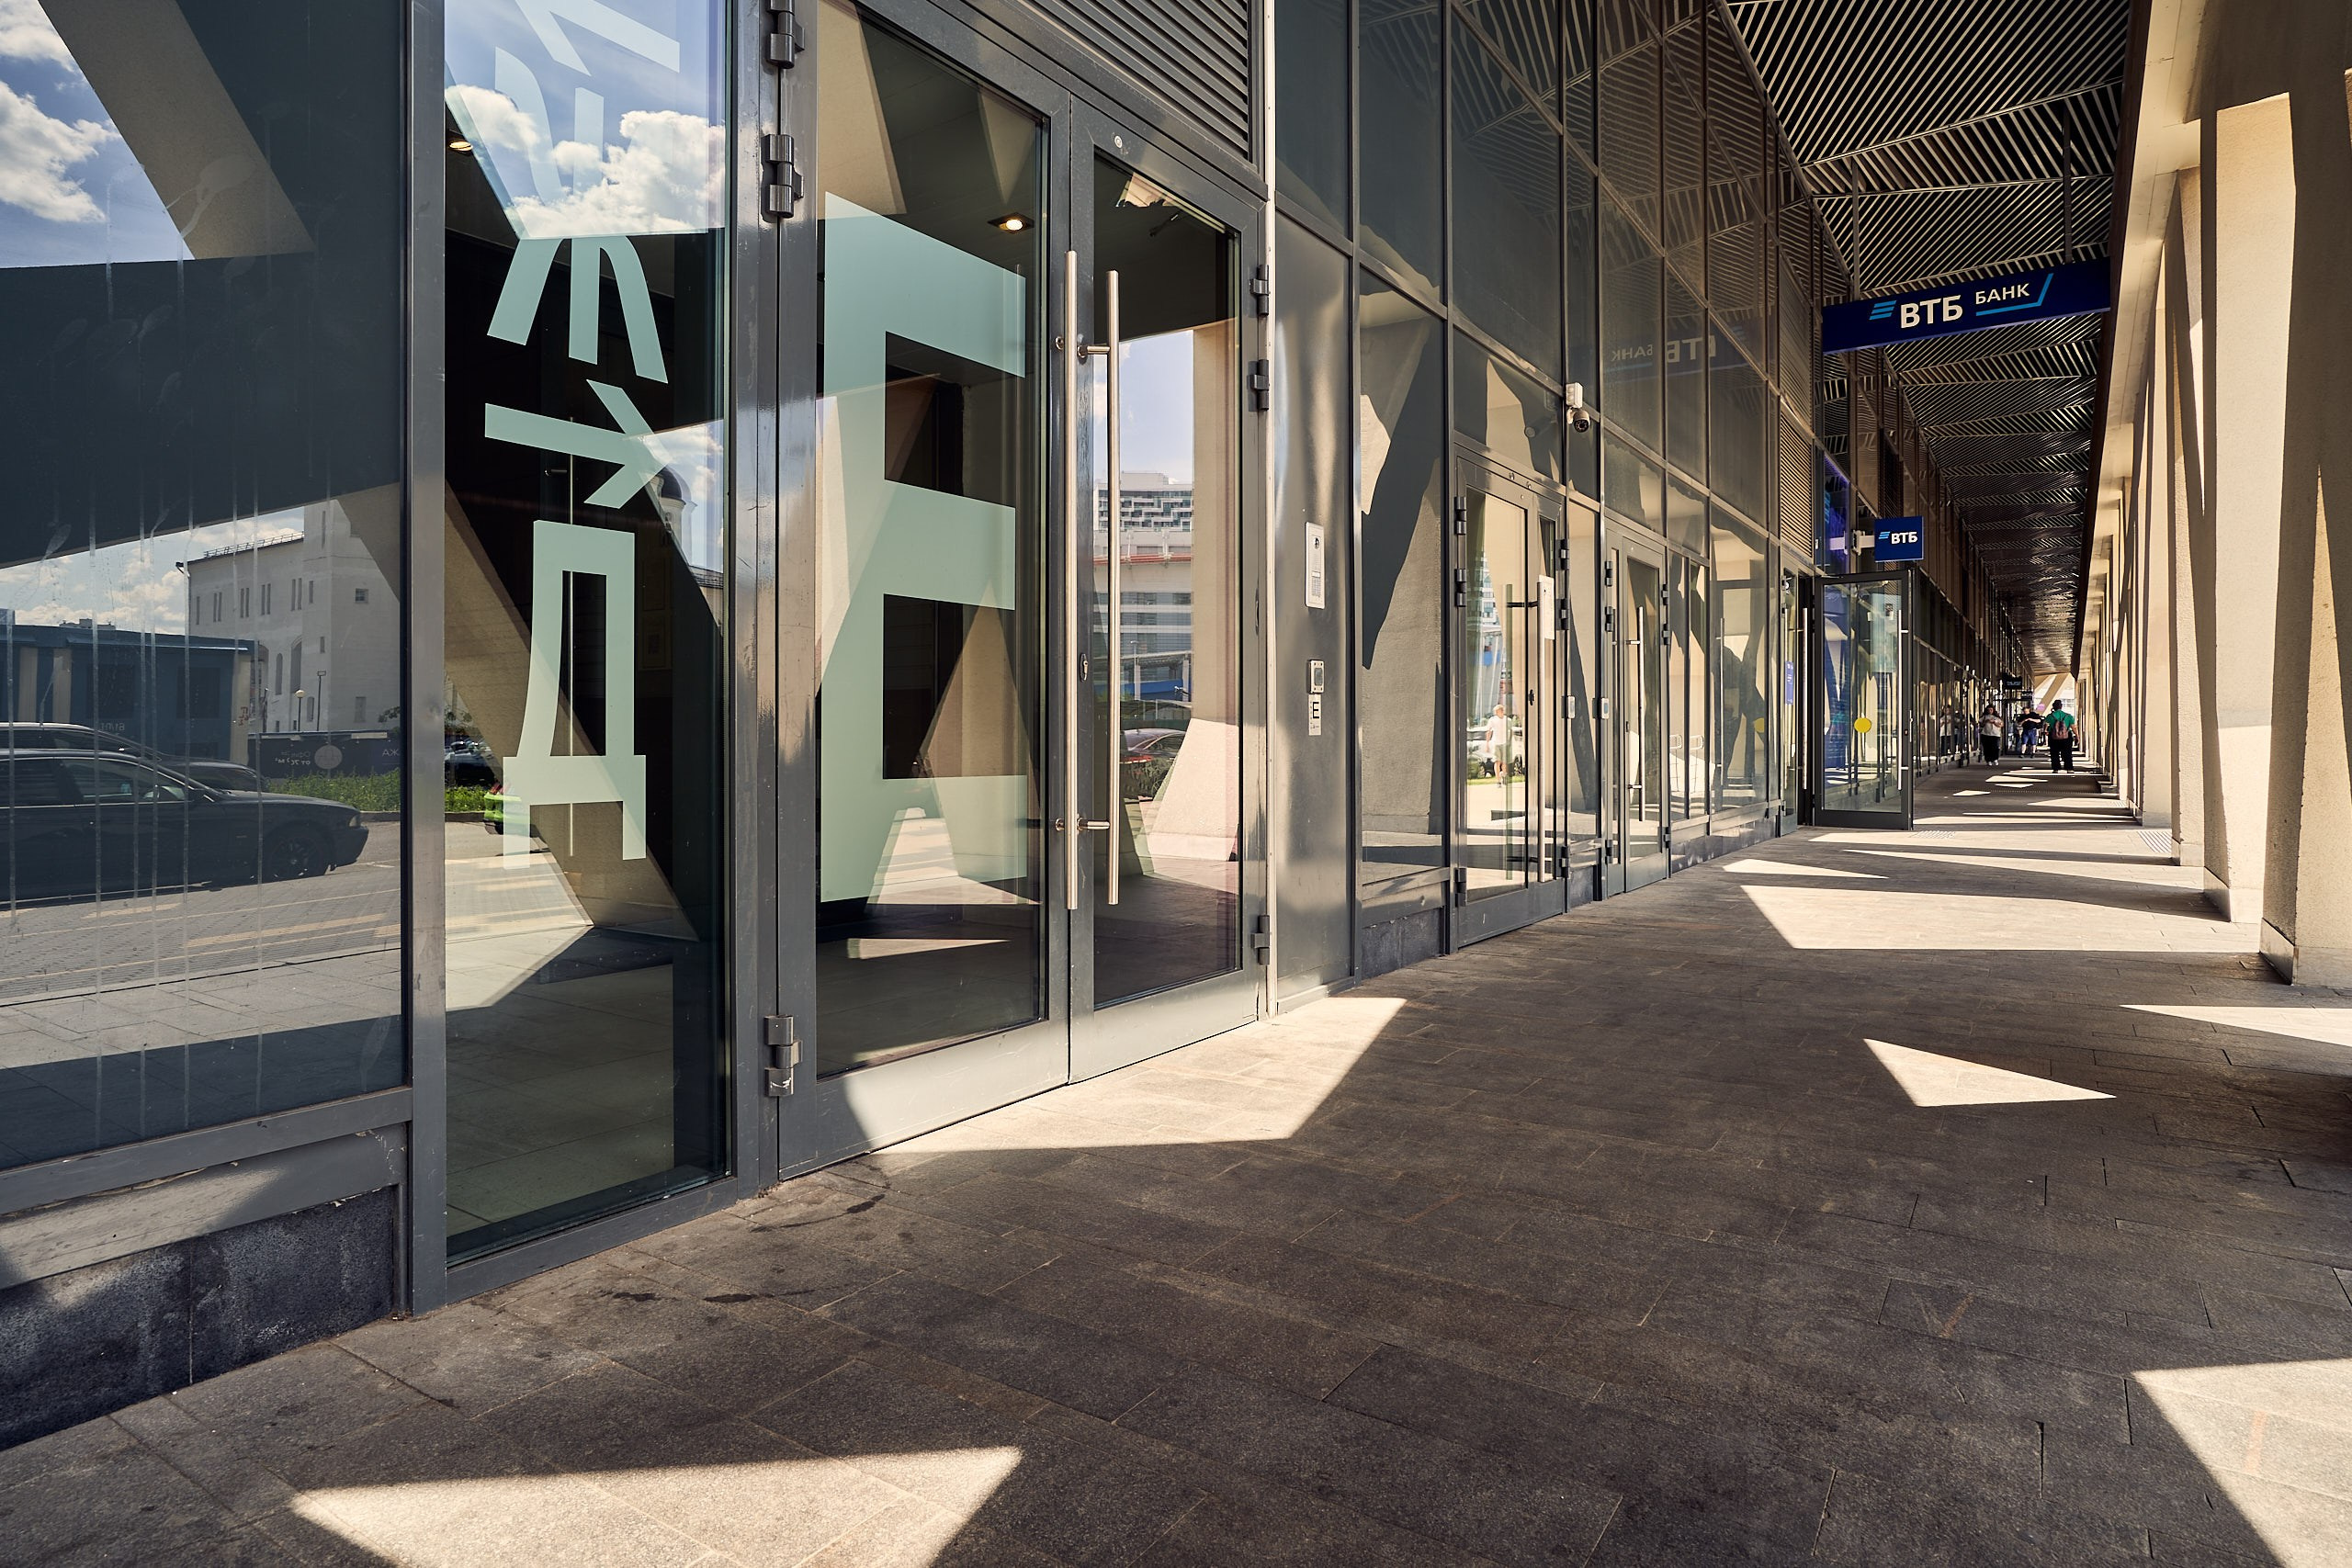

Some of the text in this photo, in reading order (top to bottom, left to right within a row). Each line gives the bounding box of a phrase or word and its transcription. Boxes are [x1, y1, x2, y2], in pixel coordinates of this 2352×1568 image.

[1900, 283, 2030, 328] ВТБ БАНК
[1891, 531, 1918, 545] ВТБ
[503, 520, 647, 869] Д
